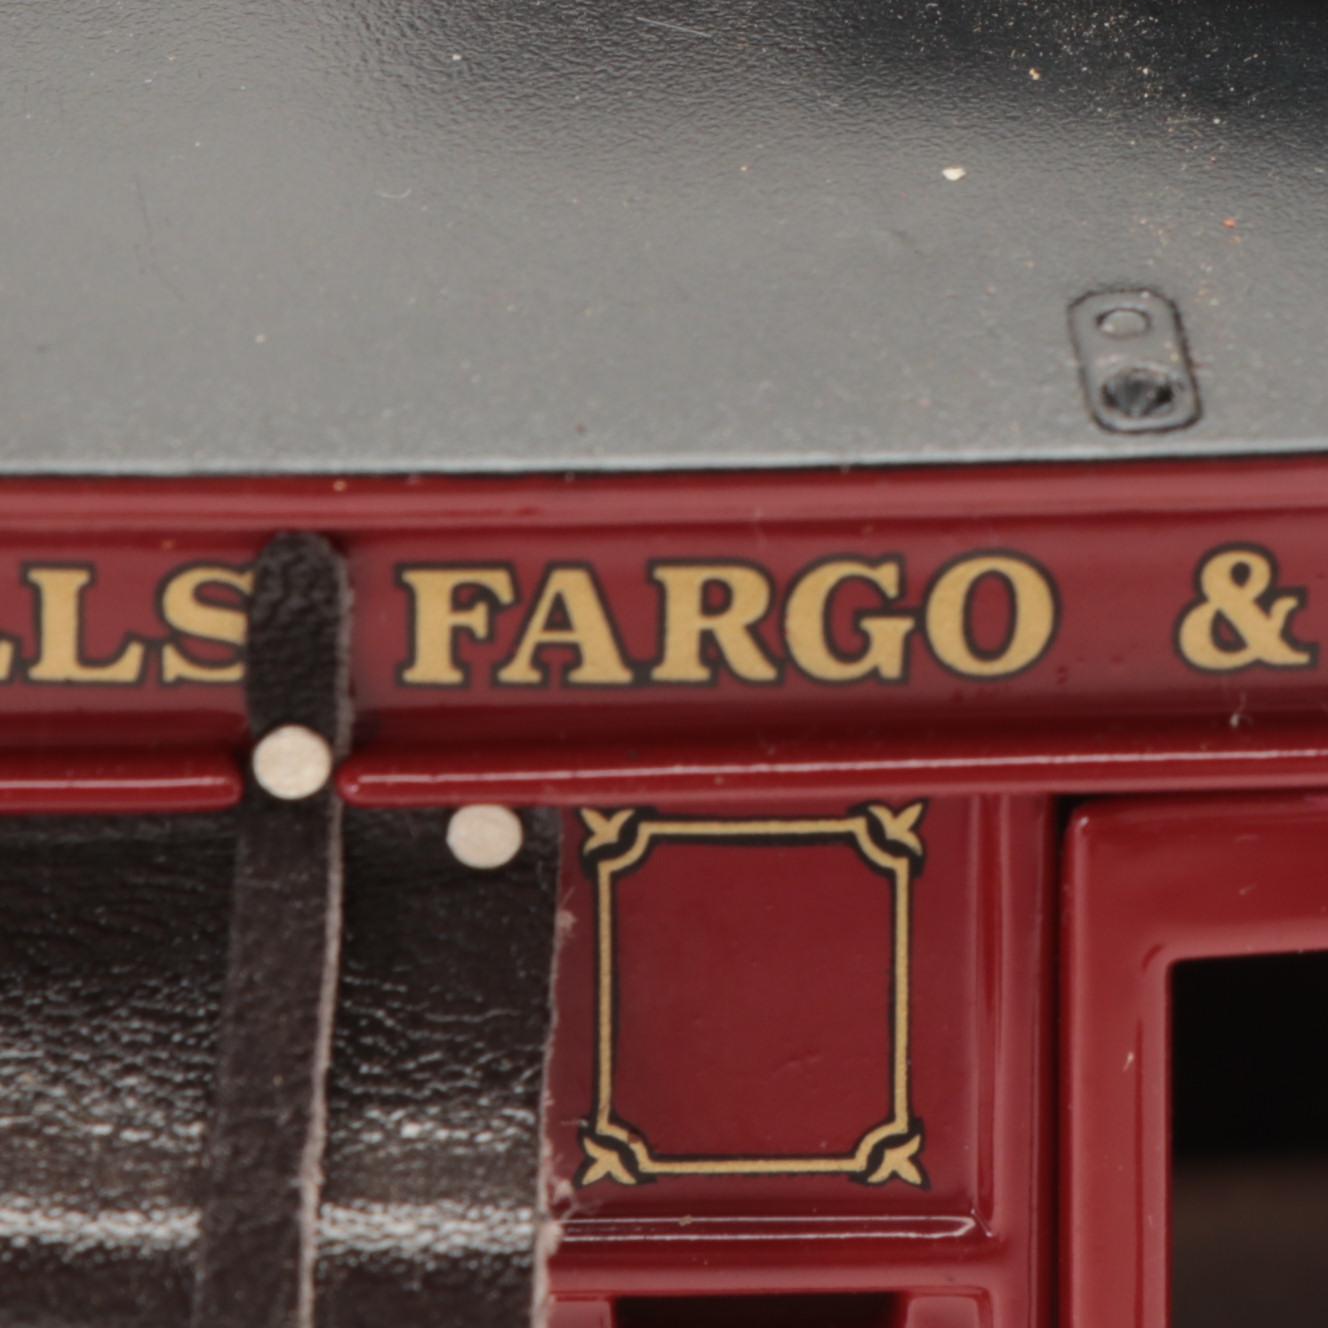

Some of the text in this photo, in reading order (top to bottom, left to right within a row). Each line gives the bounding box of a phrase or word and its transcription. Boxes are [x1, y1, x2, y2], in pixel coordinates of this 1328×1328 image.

[0, 564, 254, 684] LS
[399, 557, 1060, 687] FARGO
[1176, 544, 1318, 673] &
